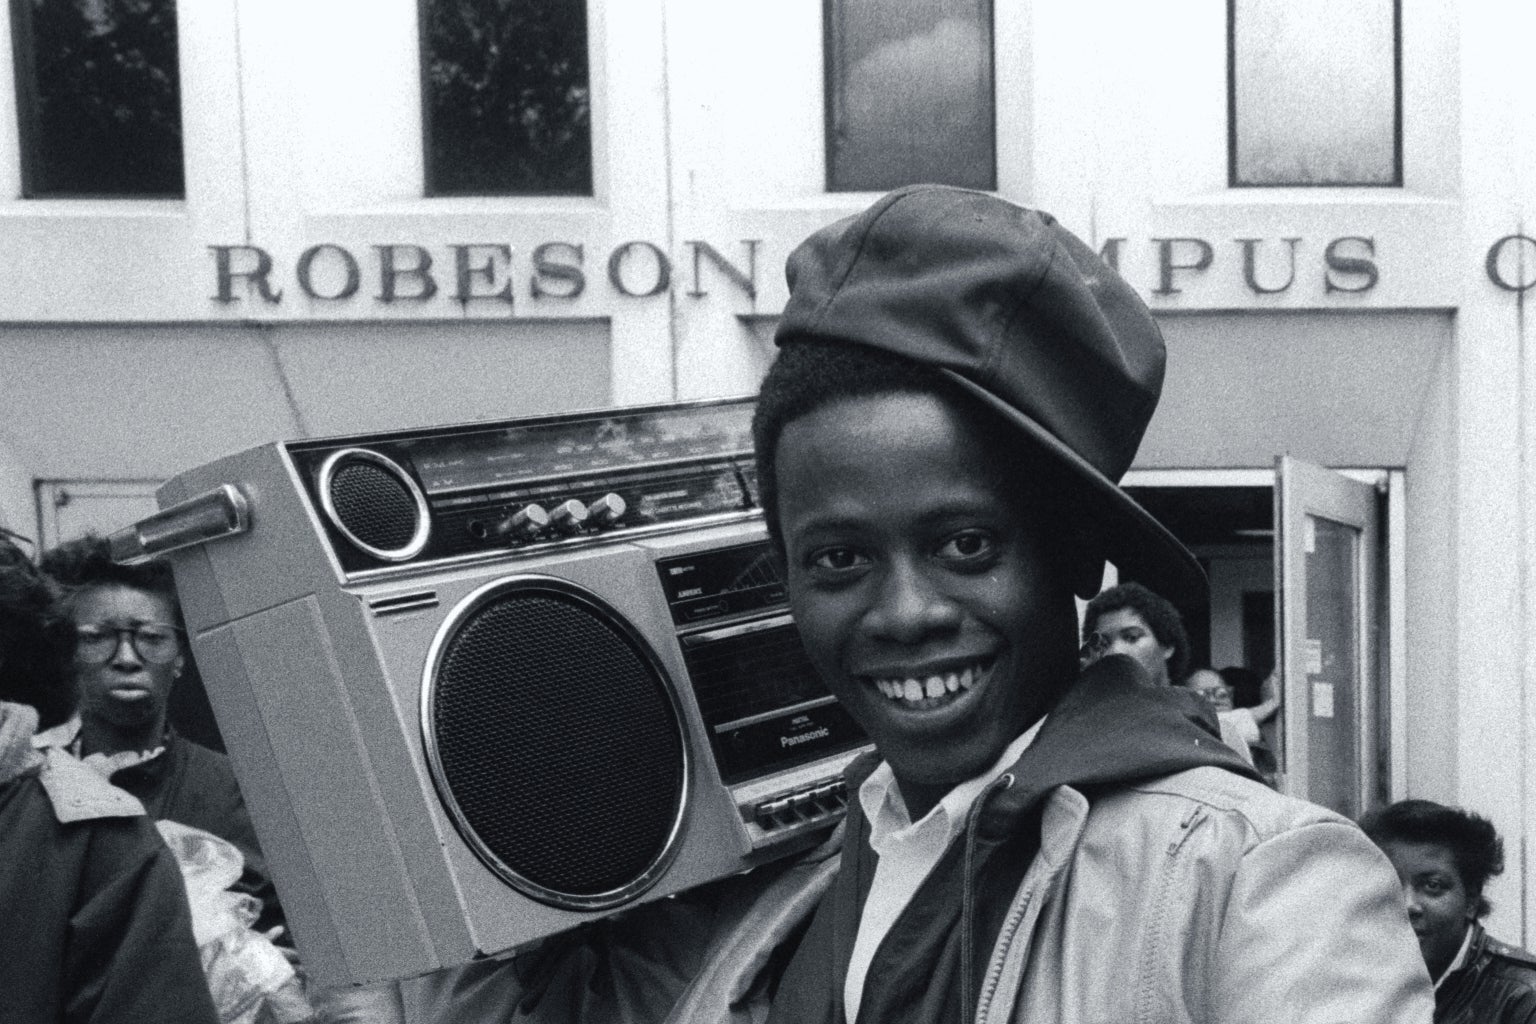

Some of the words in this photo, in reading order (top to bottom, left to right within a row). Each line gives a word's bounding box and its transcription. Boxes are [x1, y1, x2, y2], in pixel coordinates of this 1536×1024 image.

[207, 240, 765, 304] ROBESON
[1101, 236, 1381, 296] PUS
[780, 726, 829, 748] Panasonic
